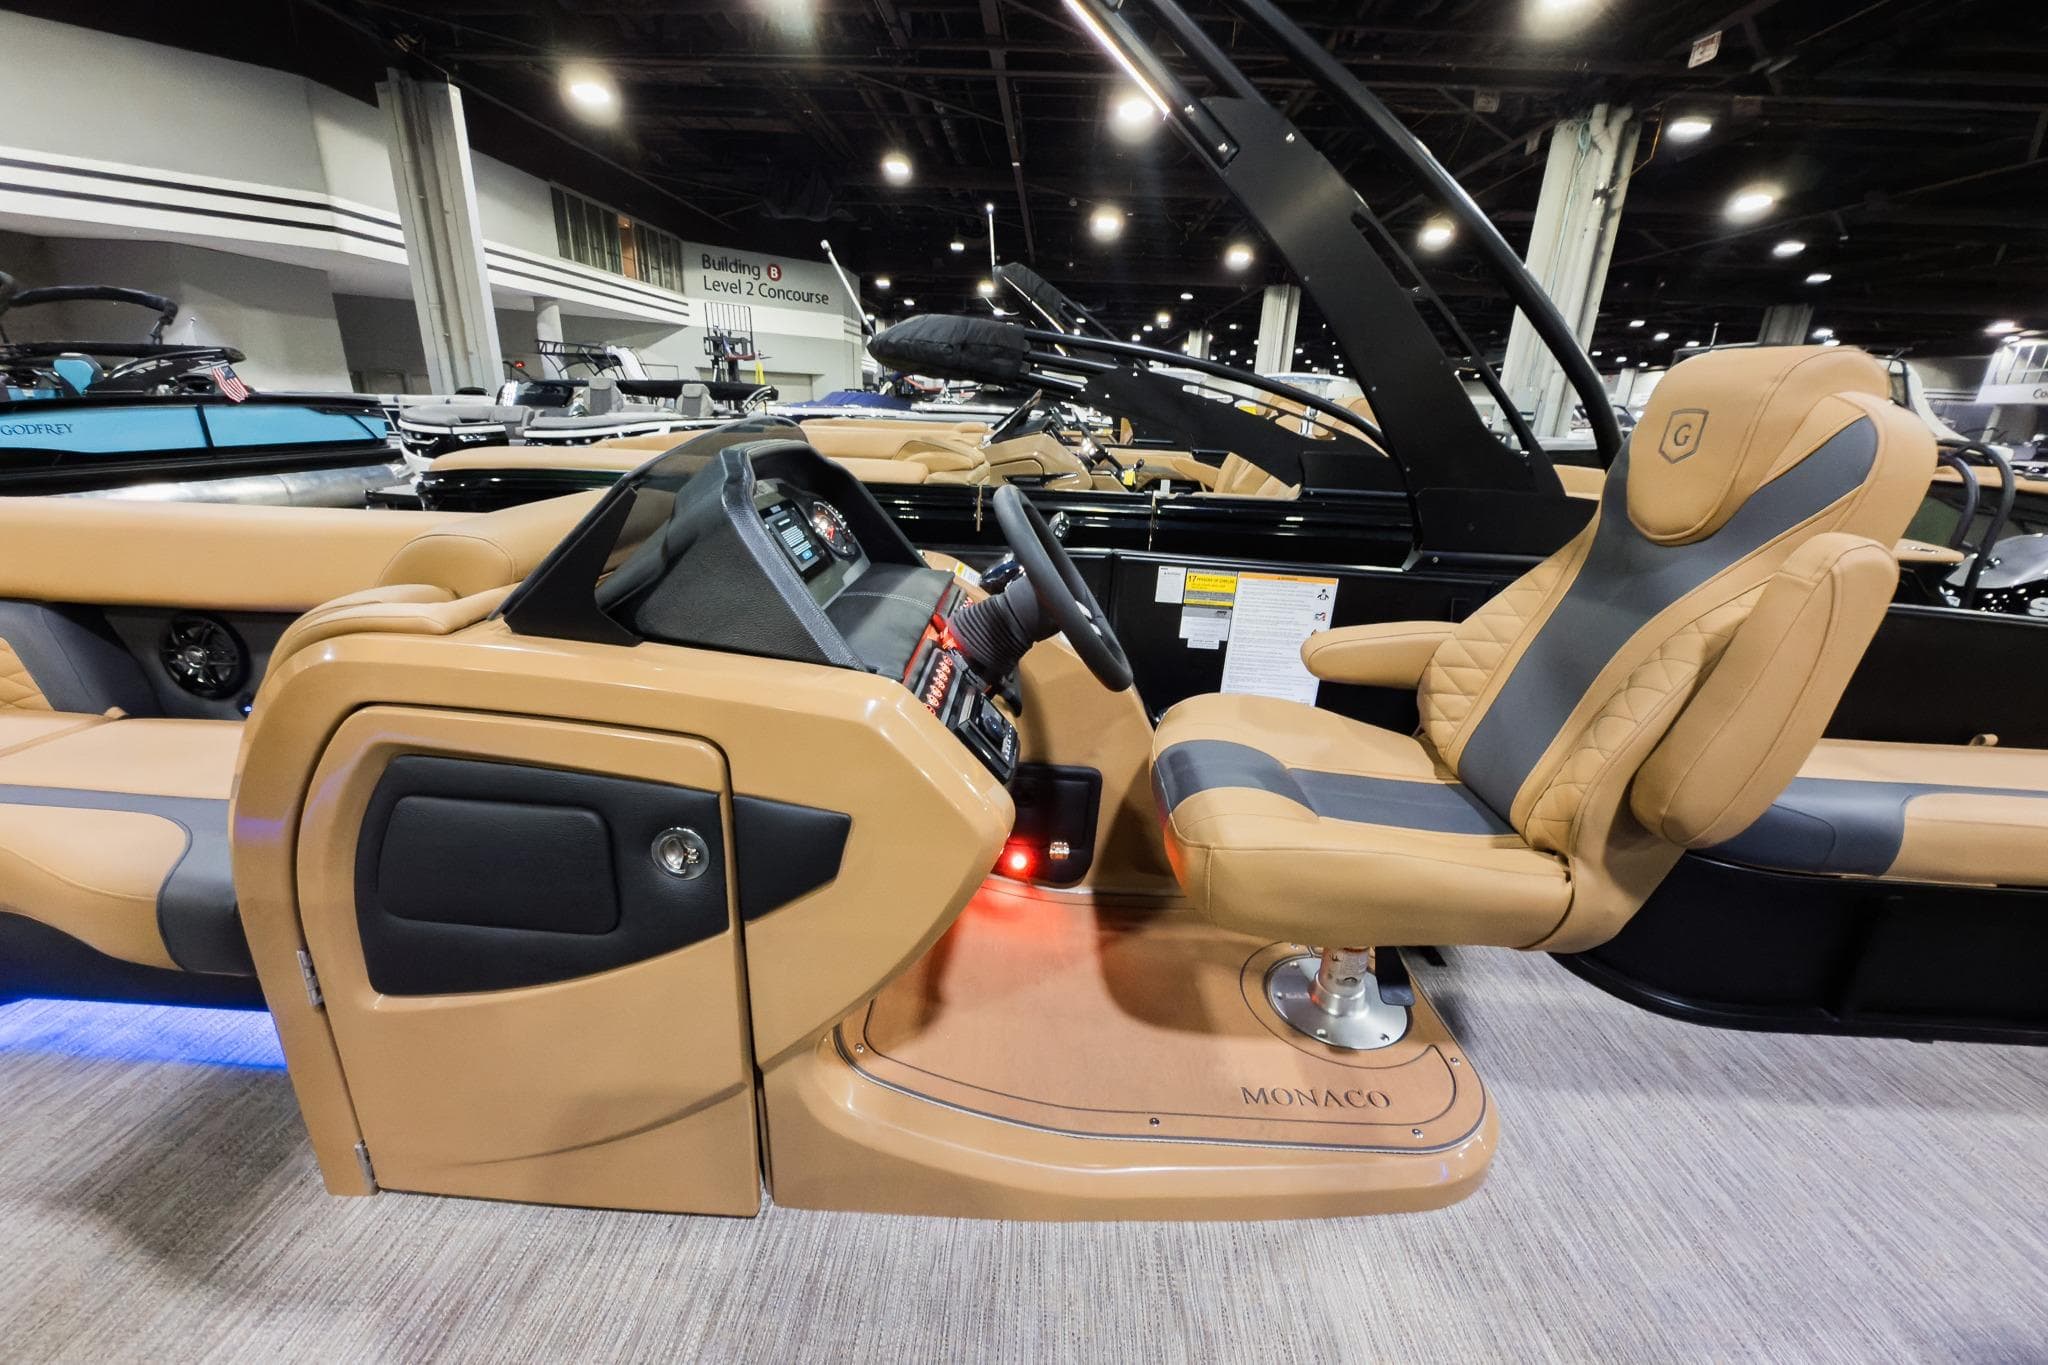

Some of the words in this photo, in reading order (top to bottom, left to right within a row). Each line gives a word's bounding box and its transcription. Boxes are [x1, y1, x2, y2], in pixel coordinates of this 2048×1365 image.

[702, 253, 761, 280] Building
[770, 266, 779, 279] B
[703, 275, 742, 294] Level
[746, 281, 755, 296] 2
[758, 283, 830, 305] Concourse
[0, 423, 73, 435] GODFREY
[1673, 423, 1692, 446] G
[1188, 575, 1198, 583] 17
[1240, 1086, 1392, 1109] MONACO
